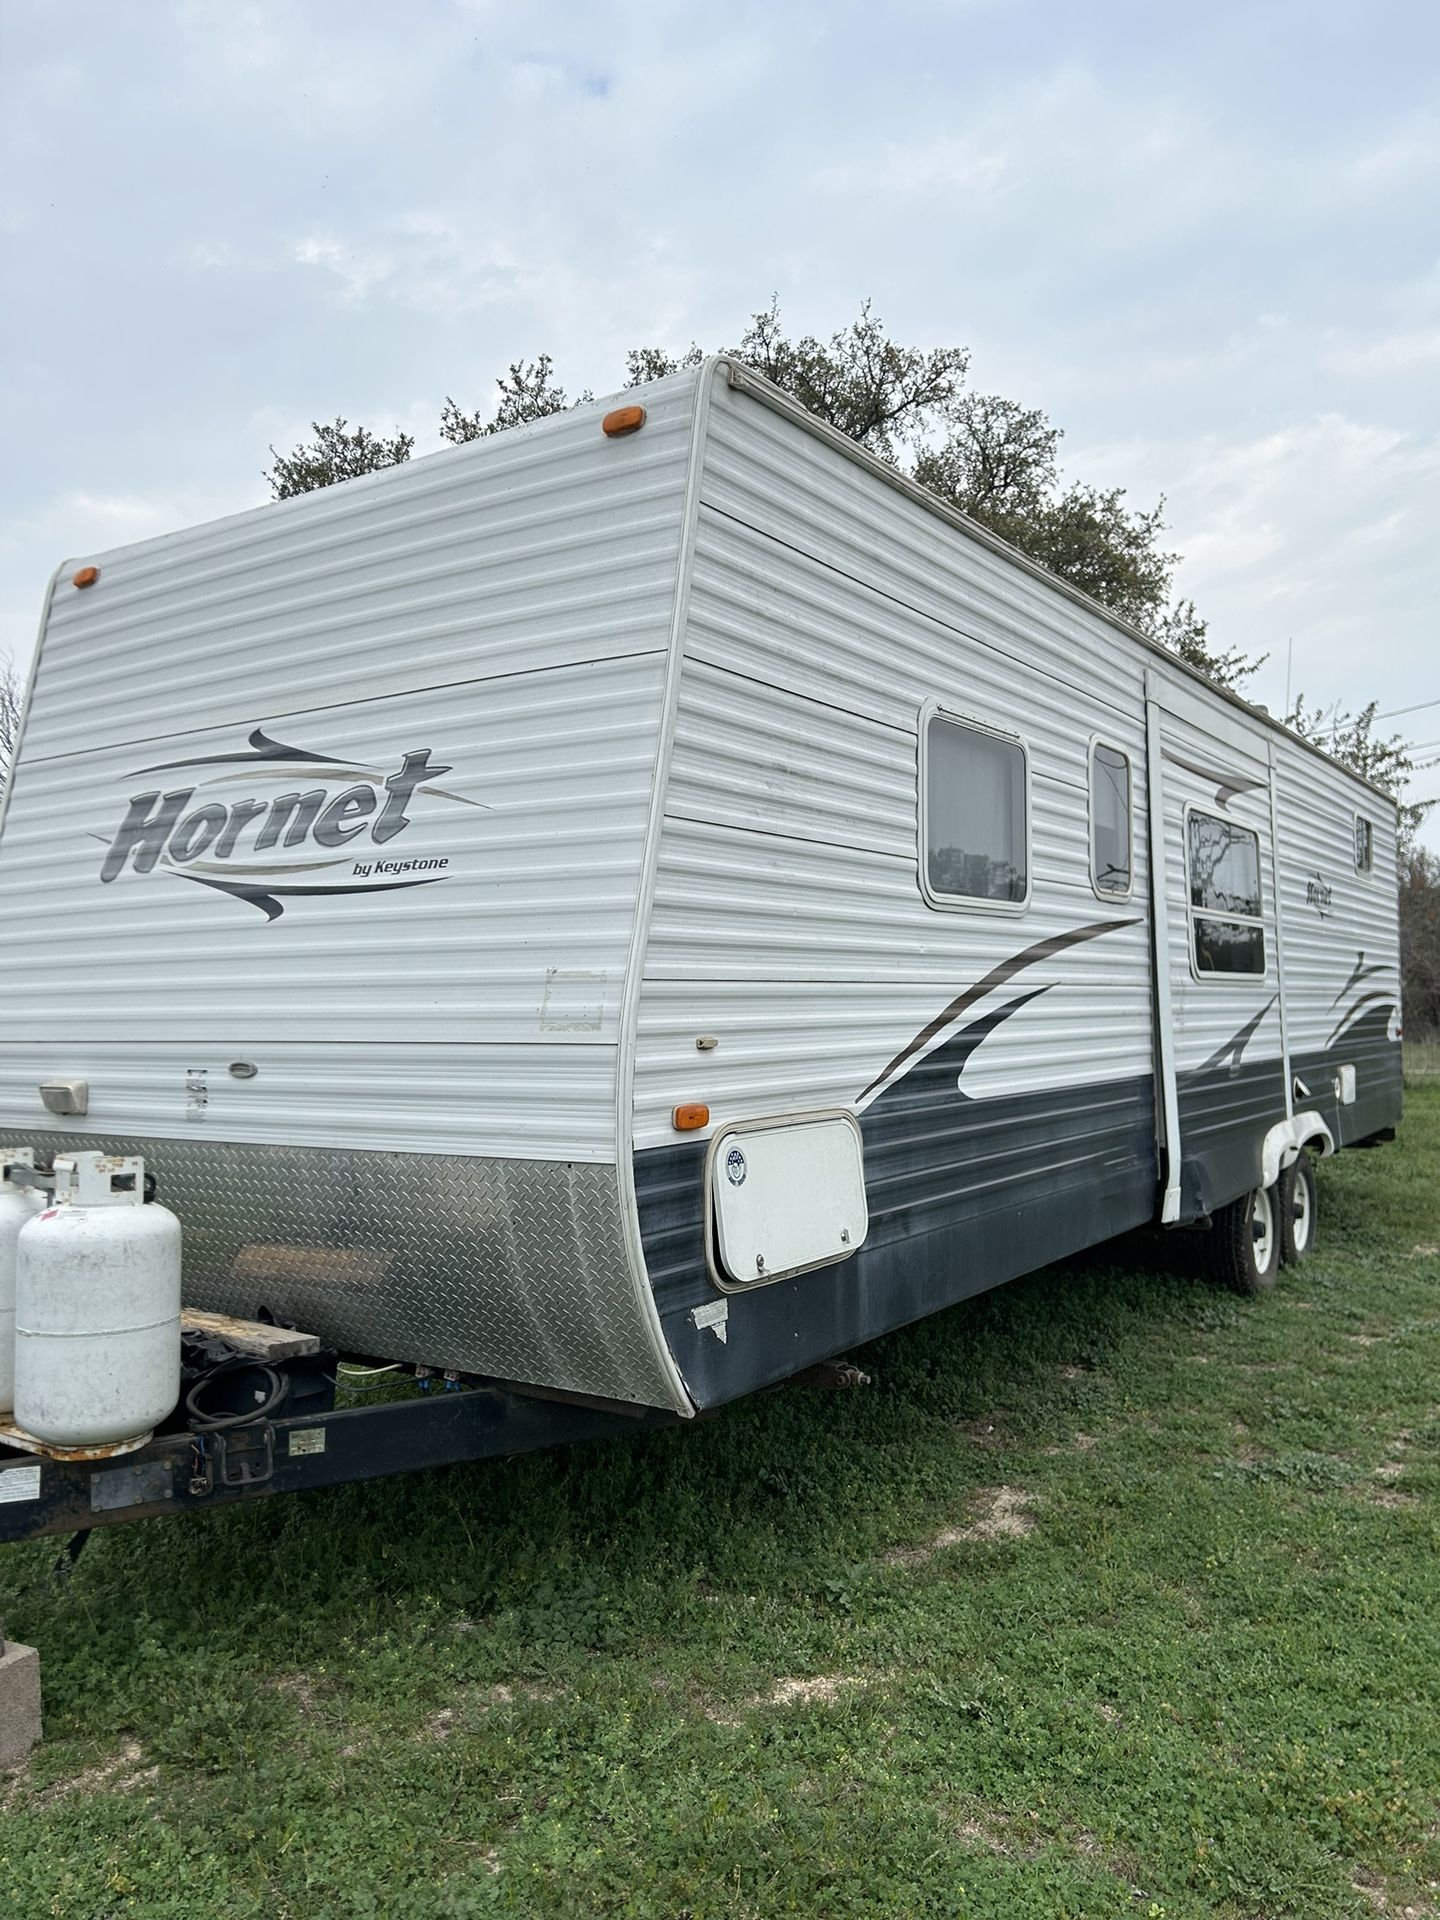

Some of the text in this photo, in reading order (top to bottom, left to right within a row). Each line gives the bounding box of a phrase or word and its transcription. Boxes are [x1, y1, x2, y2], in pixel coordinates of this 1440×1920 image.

[99, 748, 453, 884] Hornet
[352, 858, 449, 878] by Keystone
